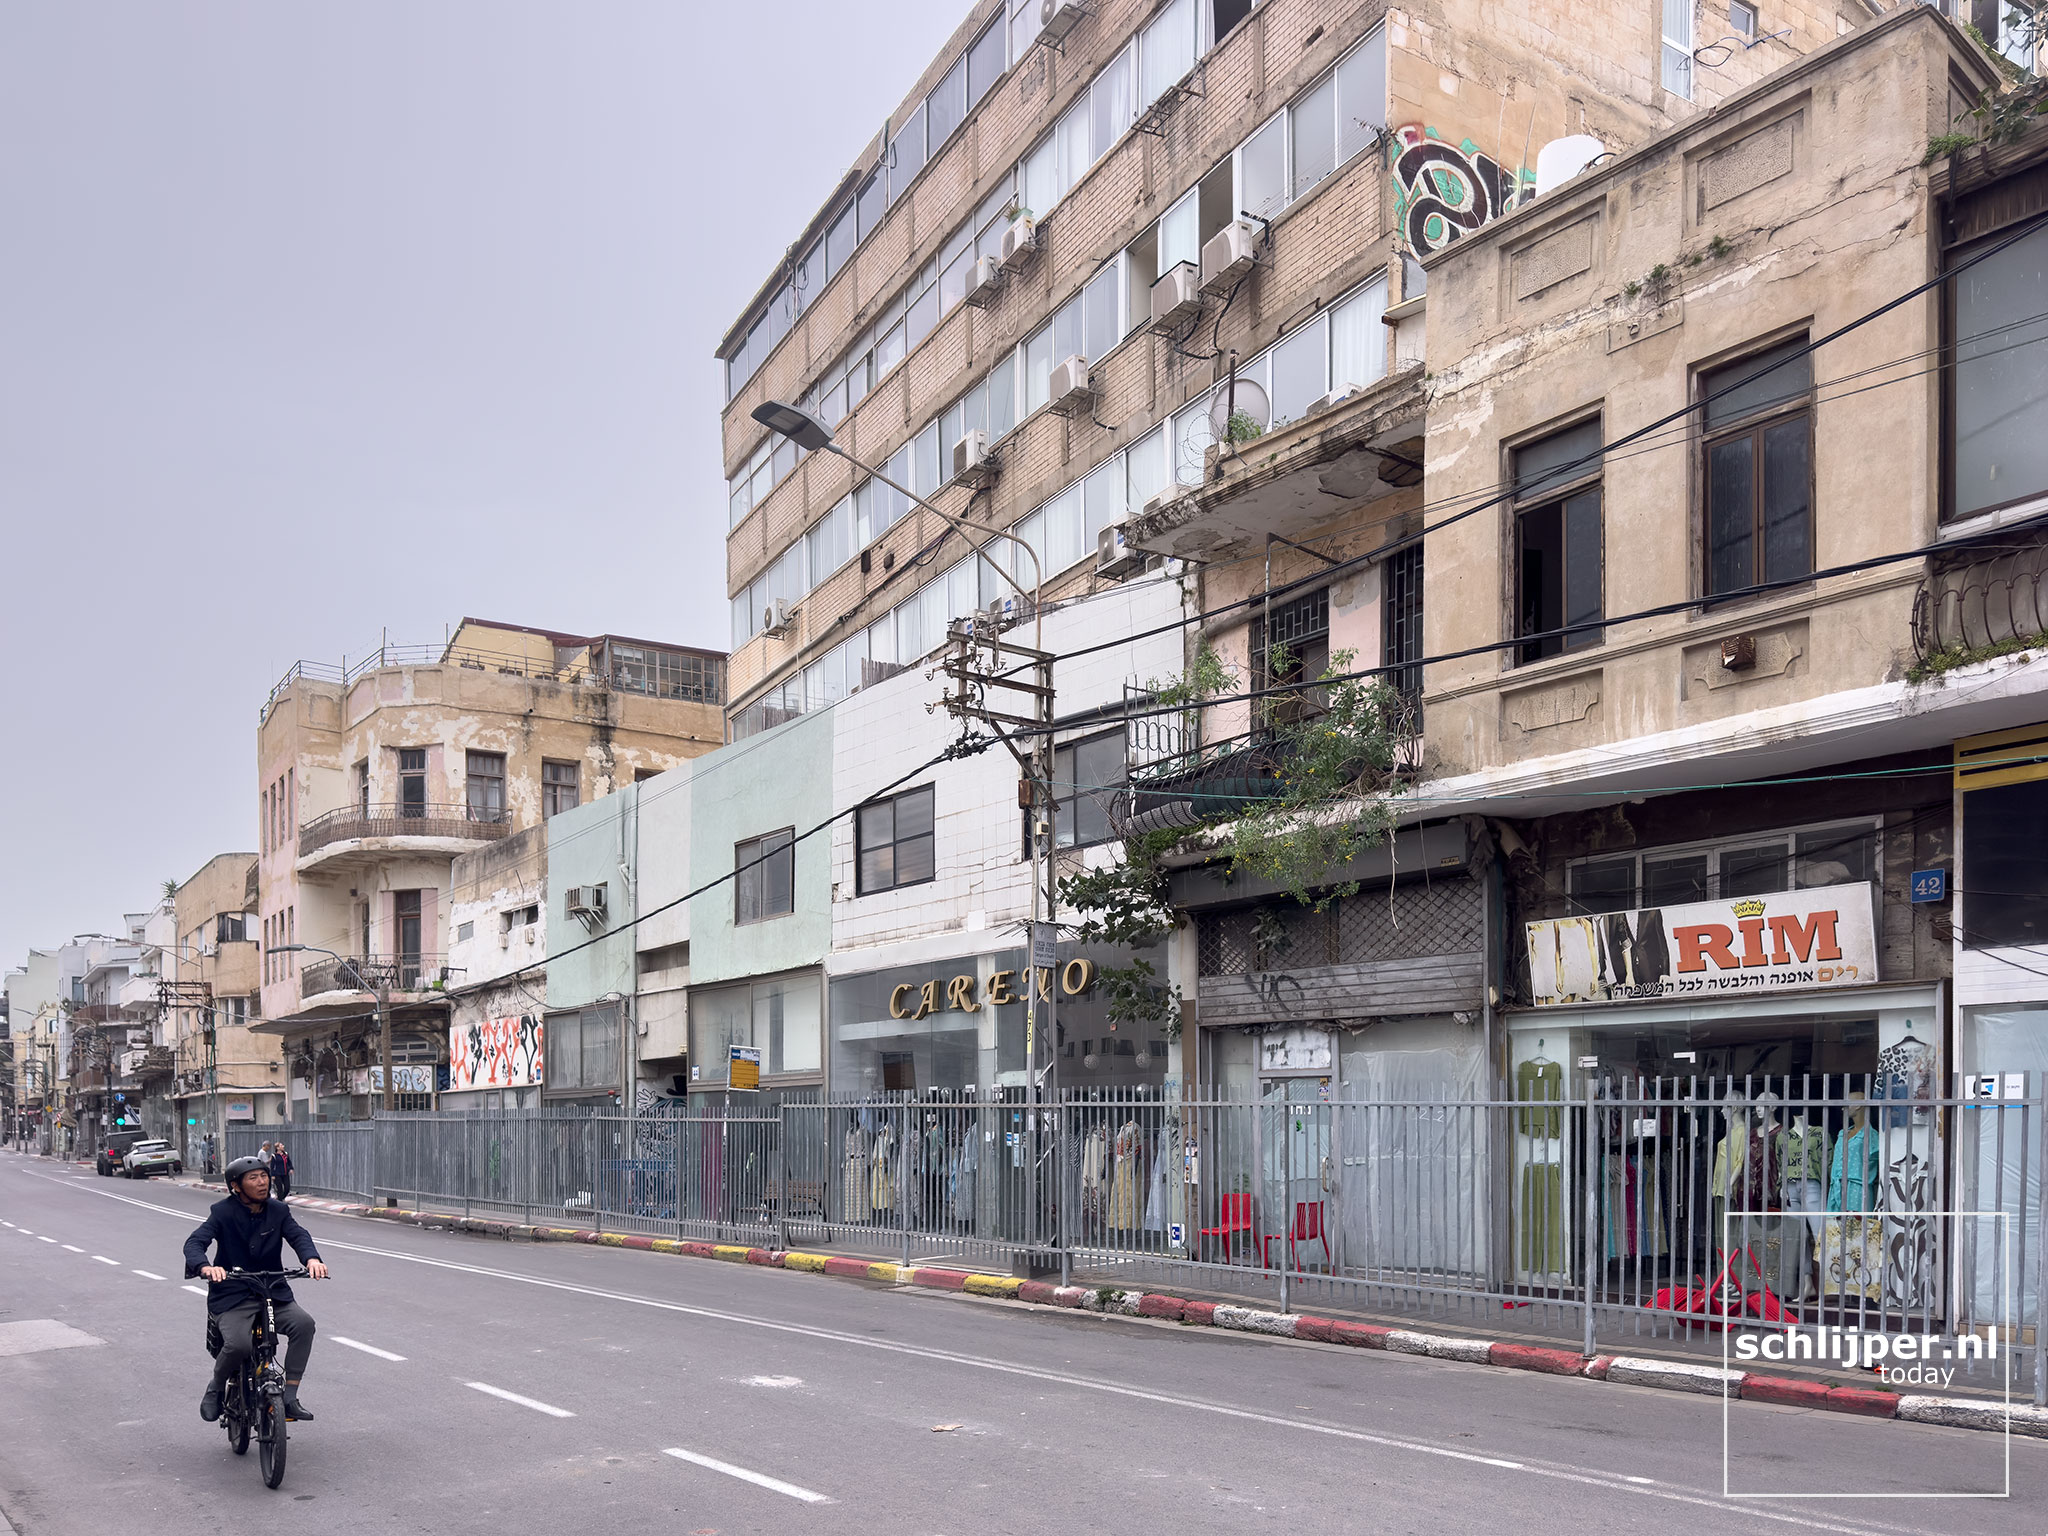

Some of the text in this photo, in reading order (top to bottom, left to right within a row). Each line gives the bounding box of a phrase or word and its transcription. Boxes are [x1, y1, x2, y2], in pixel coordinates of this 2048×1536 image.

[1915, 877, 1941, 896] 42
[1672, 909, 1843, 973] RIM
[1614, 965, 1858, 998] רים אופנה והלבשה לכל המשפחה
